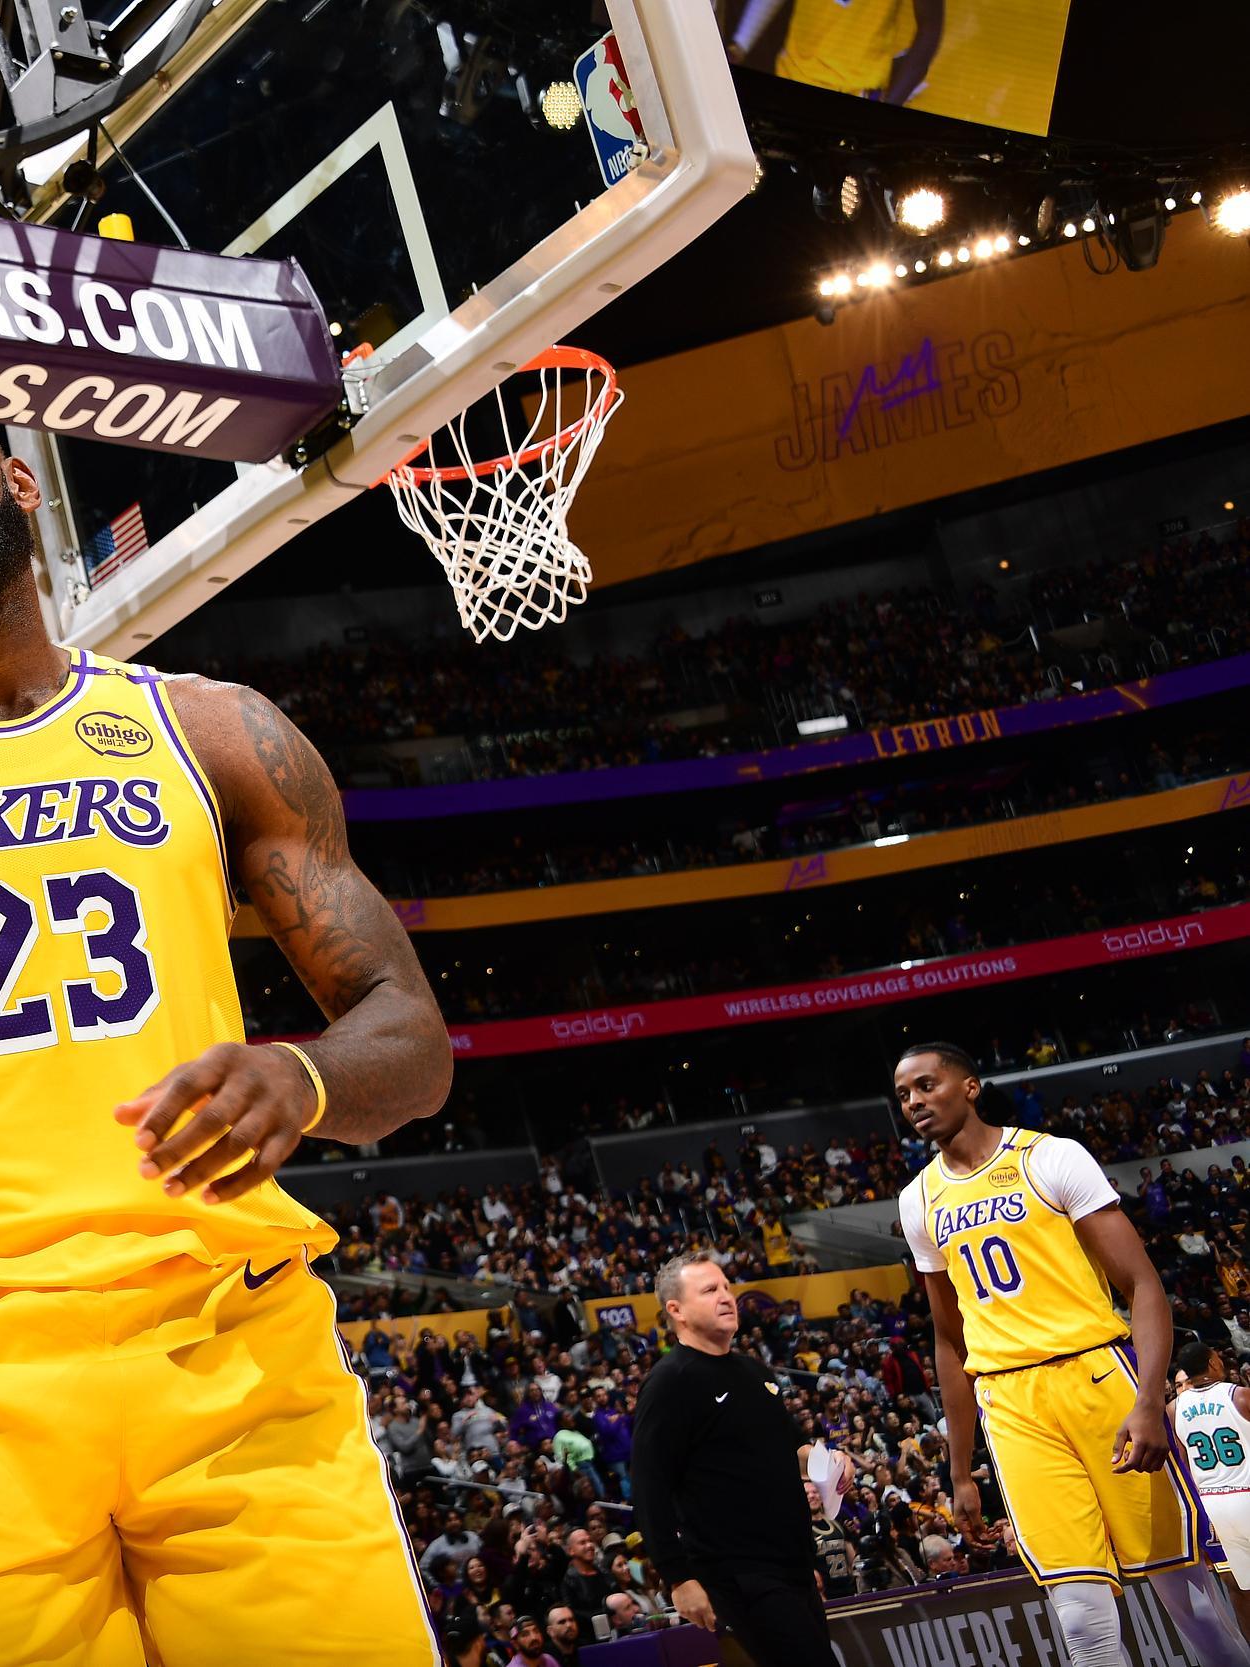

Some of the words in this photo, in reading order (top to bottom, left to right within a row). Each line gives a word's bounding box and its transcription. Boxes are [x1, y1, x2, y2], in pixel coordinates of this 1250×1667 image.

[774, 330, 1022, 472] JAMES
[82, 722, 148, 745] bibigo
[97, 737, 126, 748] 비비고
[870, 708, 1003, 758] LEBRON
[1102, 922, 1204, 952] boldyn
[724, 992, 812, 1017] WIRELESS
[814, 976, 910, 1006] COVERAGE
[912, 957, 1018, 989] SOLUTIONS
[551, 1012, 645, 1039] boldyn
[991, 1171, 1019, 1182] bibigo
[934, 1192, 1027, 1249] LAKERS
[959, 1235, 1024, 1304] 10
[600, 1307, 632, 1328] 103
[1182, 1402, 1225, 1423] SMART
[1186, 1426, 1246, 1471] 36
